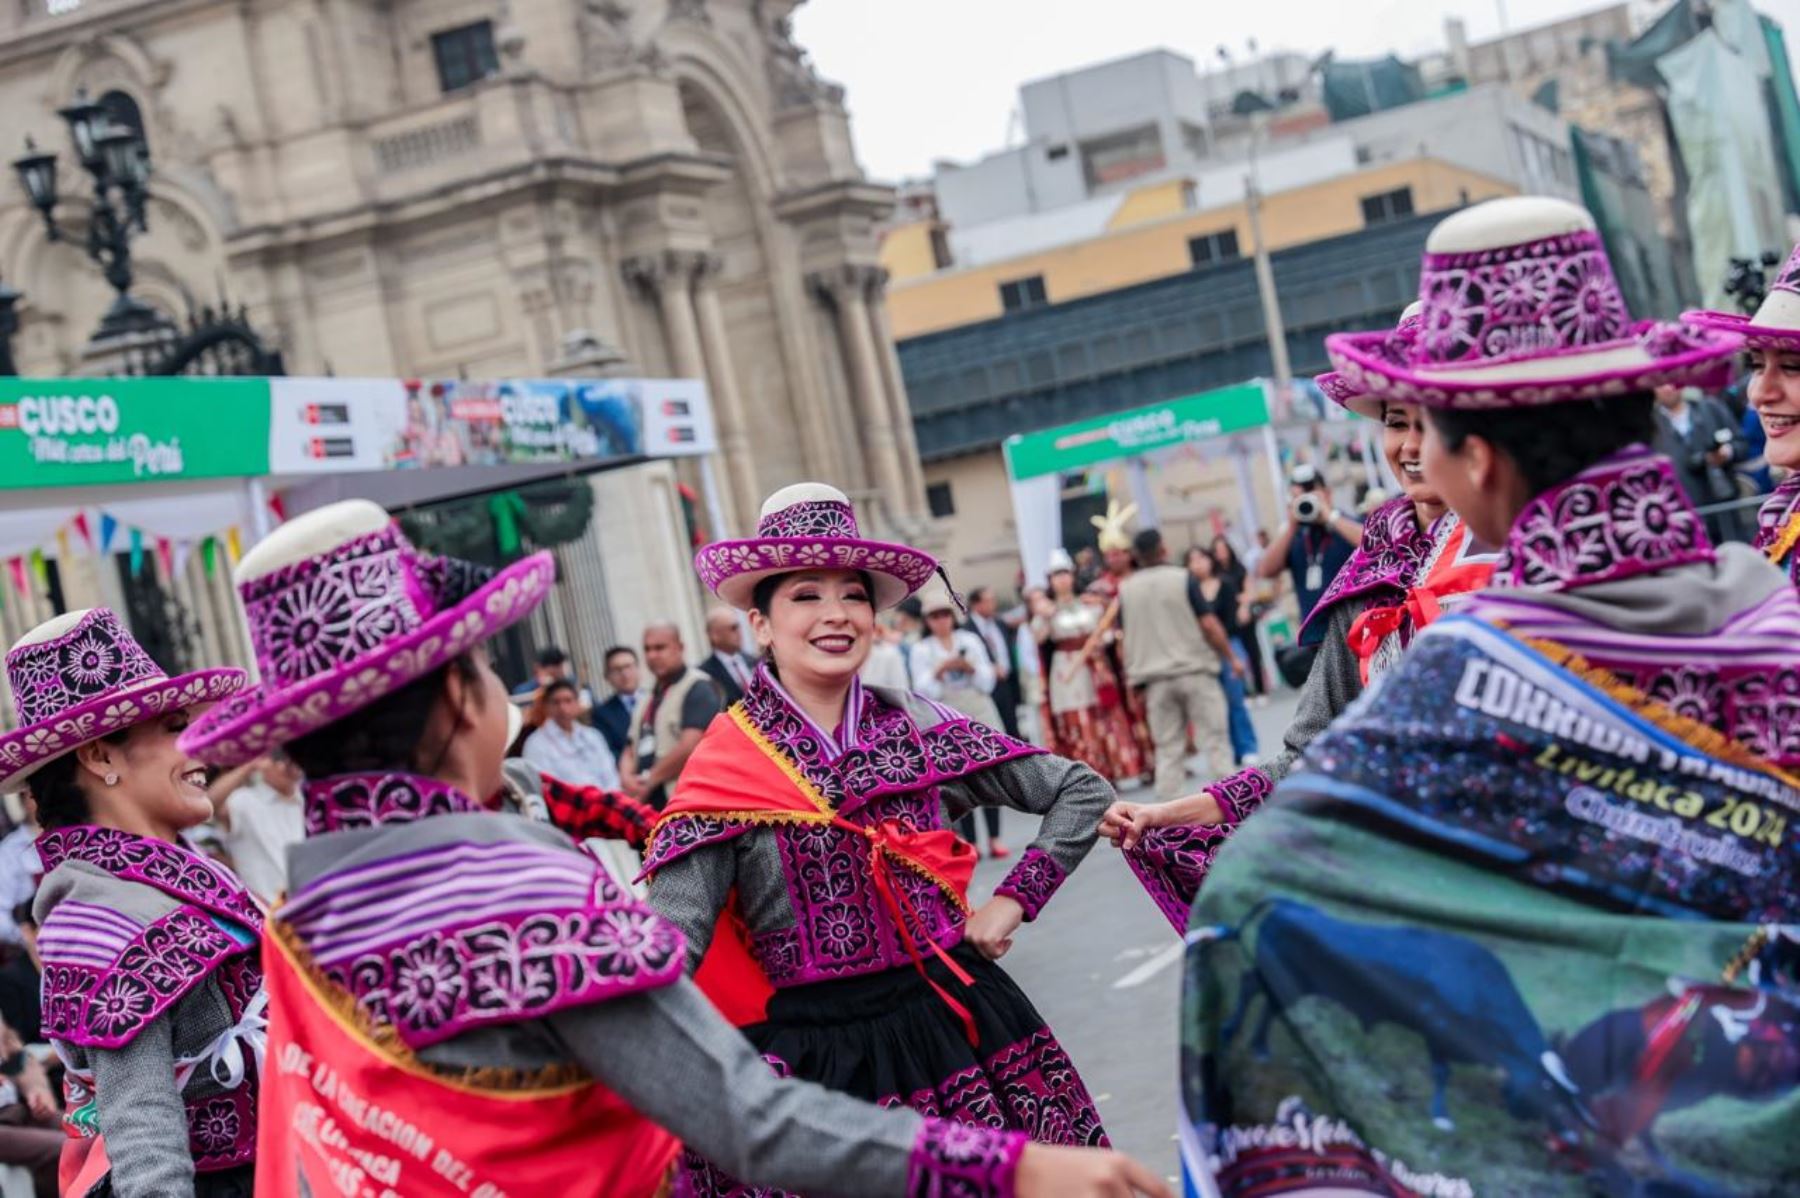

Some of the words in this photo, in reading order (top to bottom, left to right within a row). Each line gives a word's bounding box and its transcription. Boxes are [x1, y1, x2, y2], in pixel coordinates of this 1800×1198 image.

[17, 394, 119, 435] CUSCO
[129, 433, 184, 477] Perú
[1535, 743, 1705, 818] Livitaca
[312, 1063, 338, 1100] LA
[431, 1147, 476, 1192] DEL
